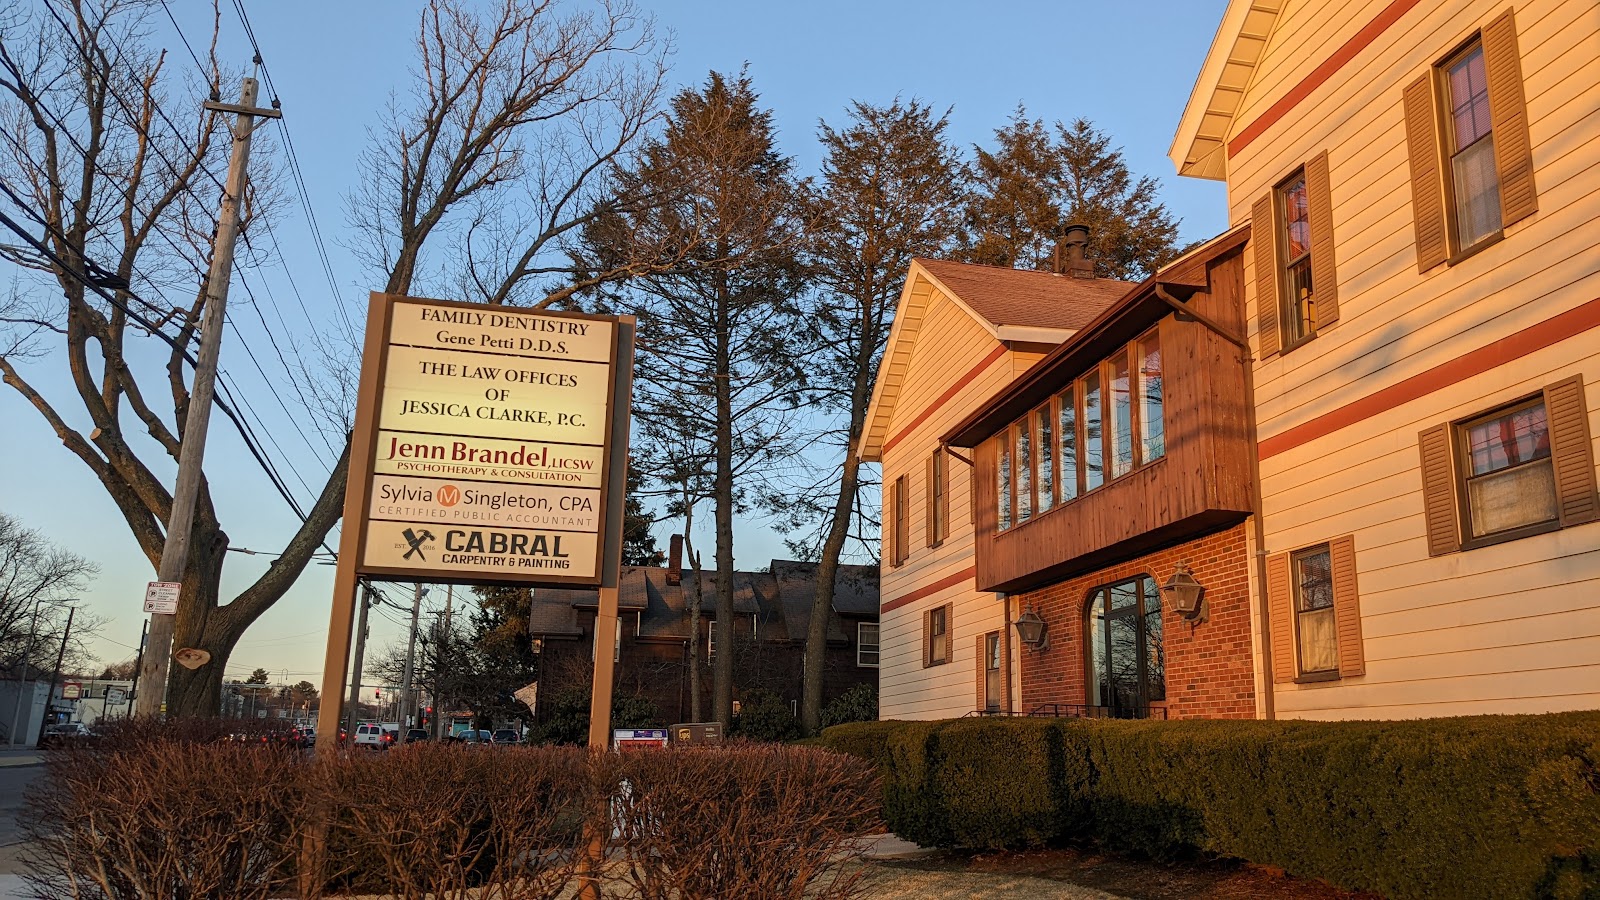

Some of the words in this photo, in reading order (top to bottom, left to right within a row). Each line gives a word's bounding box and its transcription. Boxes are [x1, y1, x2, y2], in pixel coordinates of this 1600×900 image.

[421, 308, 486, 327] FAMILY
[490, 315, 590, 336] DENTISTRY
[436, 331, 475, 346] Gene
[480, 335, 514, 348] Petti
[519, 338, 569, 354] D.D.S.
[419, 361, 457, 377] THE
[461, 366, 502, 380] LAW
[504, 370, 578, 387] OFFICES
[485, 388, 510, 402] OF
[400, 400, 471, 418] JESSICA
[476, 406, 552, 425] CLARKE,
[558, 413, 586, 427] P.C.
[387, 437, 445, 460] Jenn
[397, 462, 488, 475] PSYCHOTHERAPY
[490, 468, 498, 476] &
[501, 470, 582, 482] CONSULTATION
[380, 484, 433, 503] Sylvia
[439, 489, 458, 503] M
[464, 489, 552, 512] Singleton,
[559, 496, 592, 512] CPA
[378, 506, 447, 518] CERTIFIED
[454, 510, 500, 521] PUBLIC
[507, 514, 592, 526] ACCOUNTANT
[445, 530, 569, 557] CABRAL
[442, 554, 507, 566] CARPENTRY
[509, 555, 515, 566] &
[518, 558, 570, 569] PAINTING
